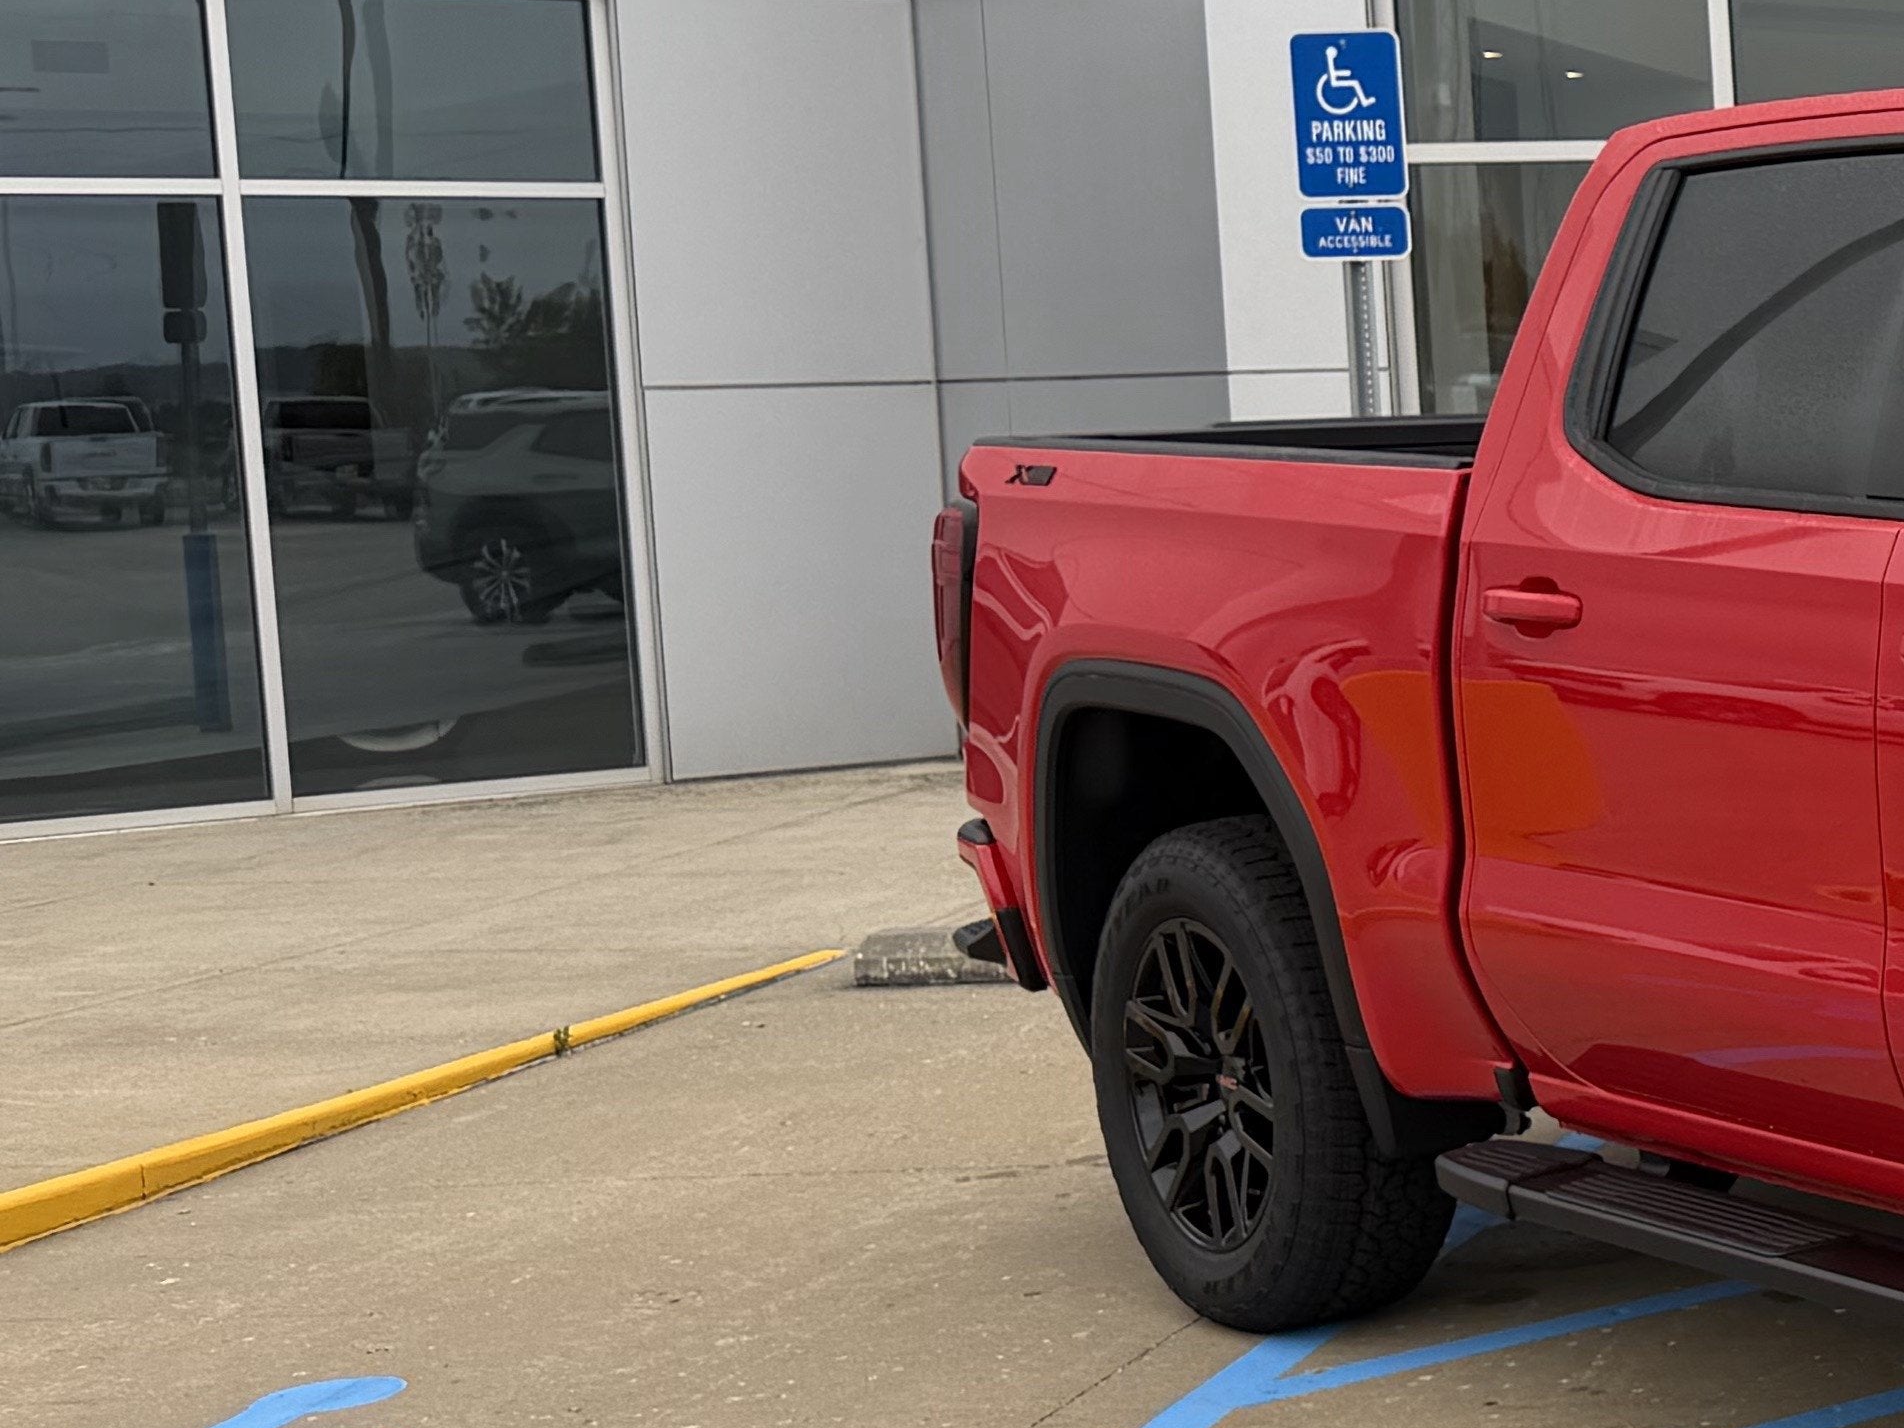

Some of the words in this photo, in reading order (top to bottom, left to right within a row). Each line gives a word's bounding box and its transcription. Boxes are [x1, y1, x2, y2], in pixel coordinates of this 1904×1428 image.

[1311, 119, 1386, 142] PARKING
[1306, 147, 1333, 164] $50
[1336, 146, 1354, 164] TO
[1359, 145, 1395, 163] $300
[1336, 166, 1367, 185] FINE
[1335, 217, 1373, 233] VAN
[1318, 234, 1393, 249] ACCESSIBLE
